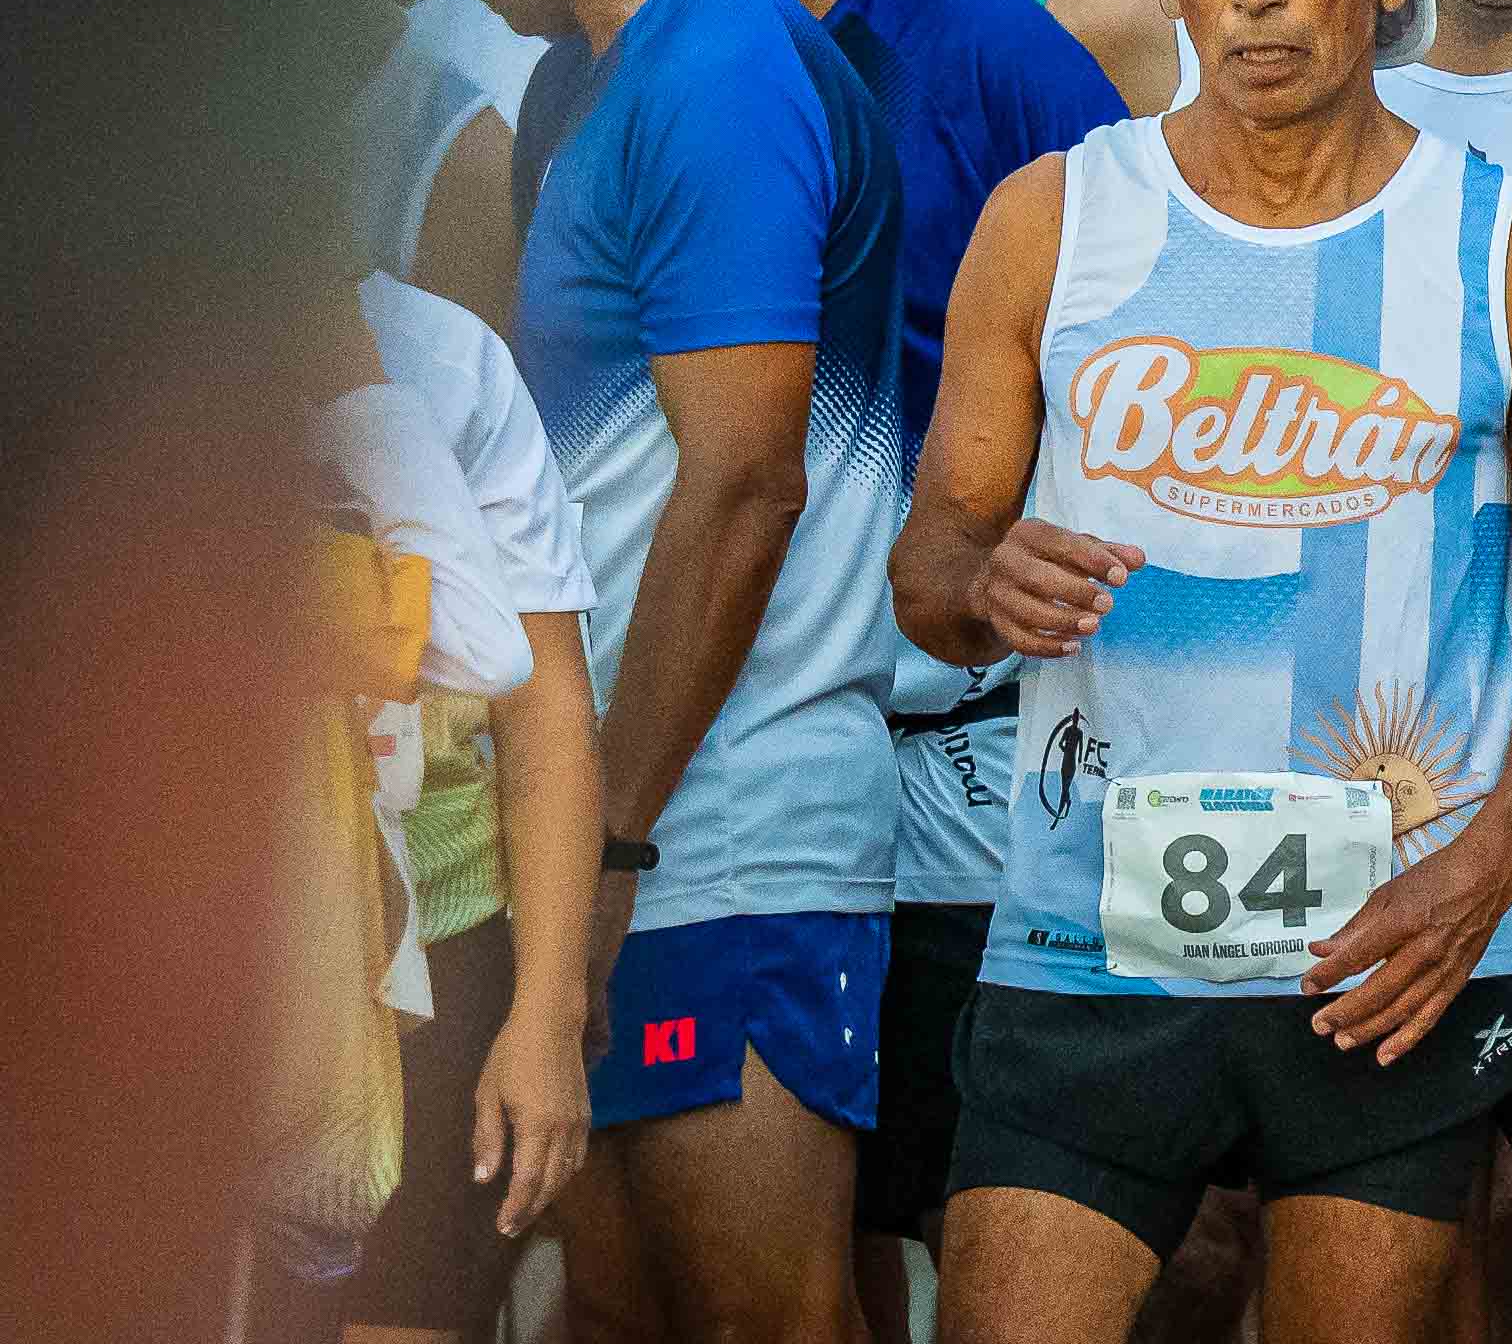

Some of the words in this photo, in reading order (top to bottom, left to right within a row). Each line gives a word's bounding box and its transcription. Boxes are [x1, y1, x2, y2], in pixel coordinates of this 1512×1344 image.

[1076, 342, 1457, 486] Beltrán
[1168, 485, 1375, 518] SUPERMERCADOS
[1161, 833, 1323, 933] 84
[1183, 944, 1210, 958] JUAN
[1212, 942, 1249, 958] ÁNGEL
[1251, 939, 1304, 957] GORORDO
